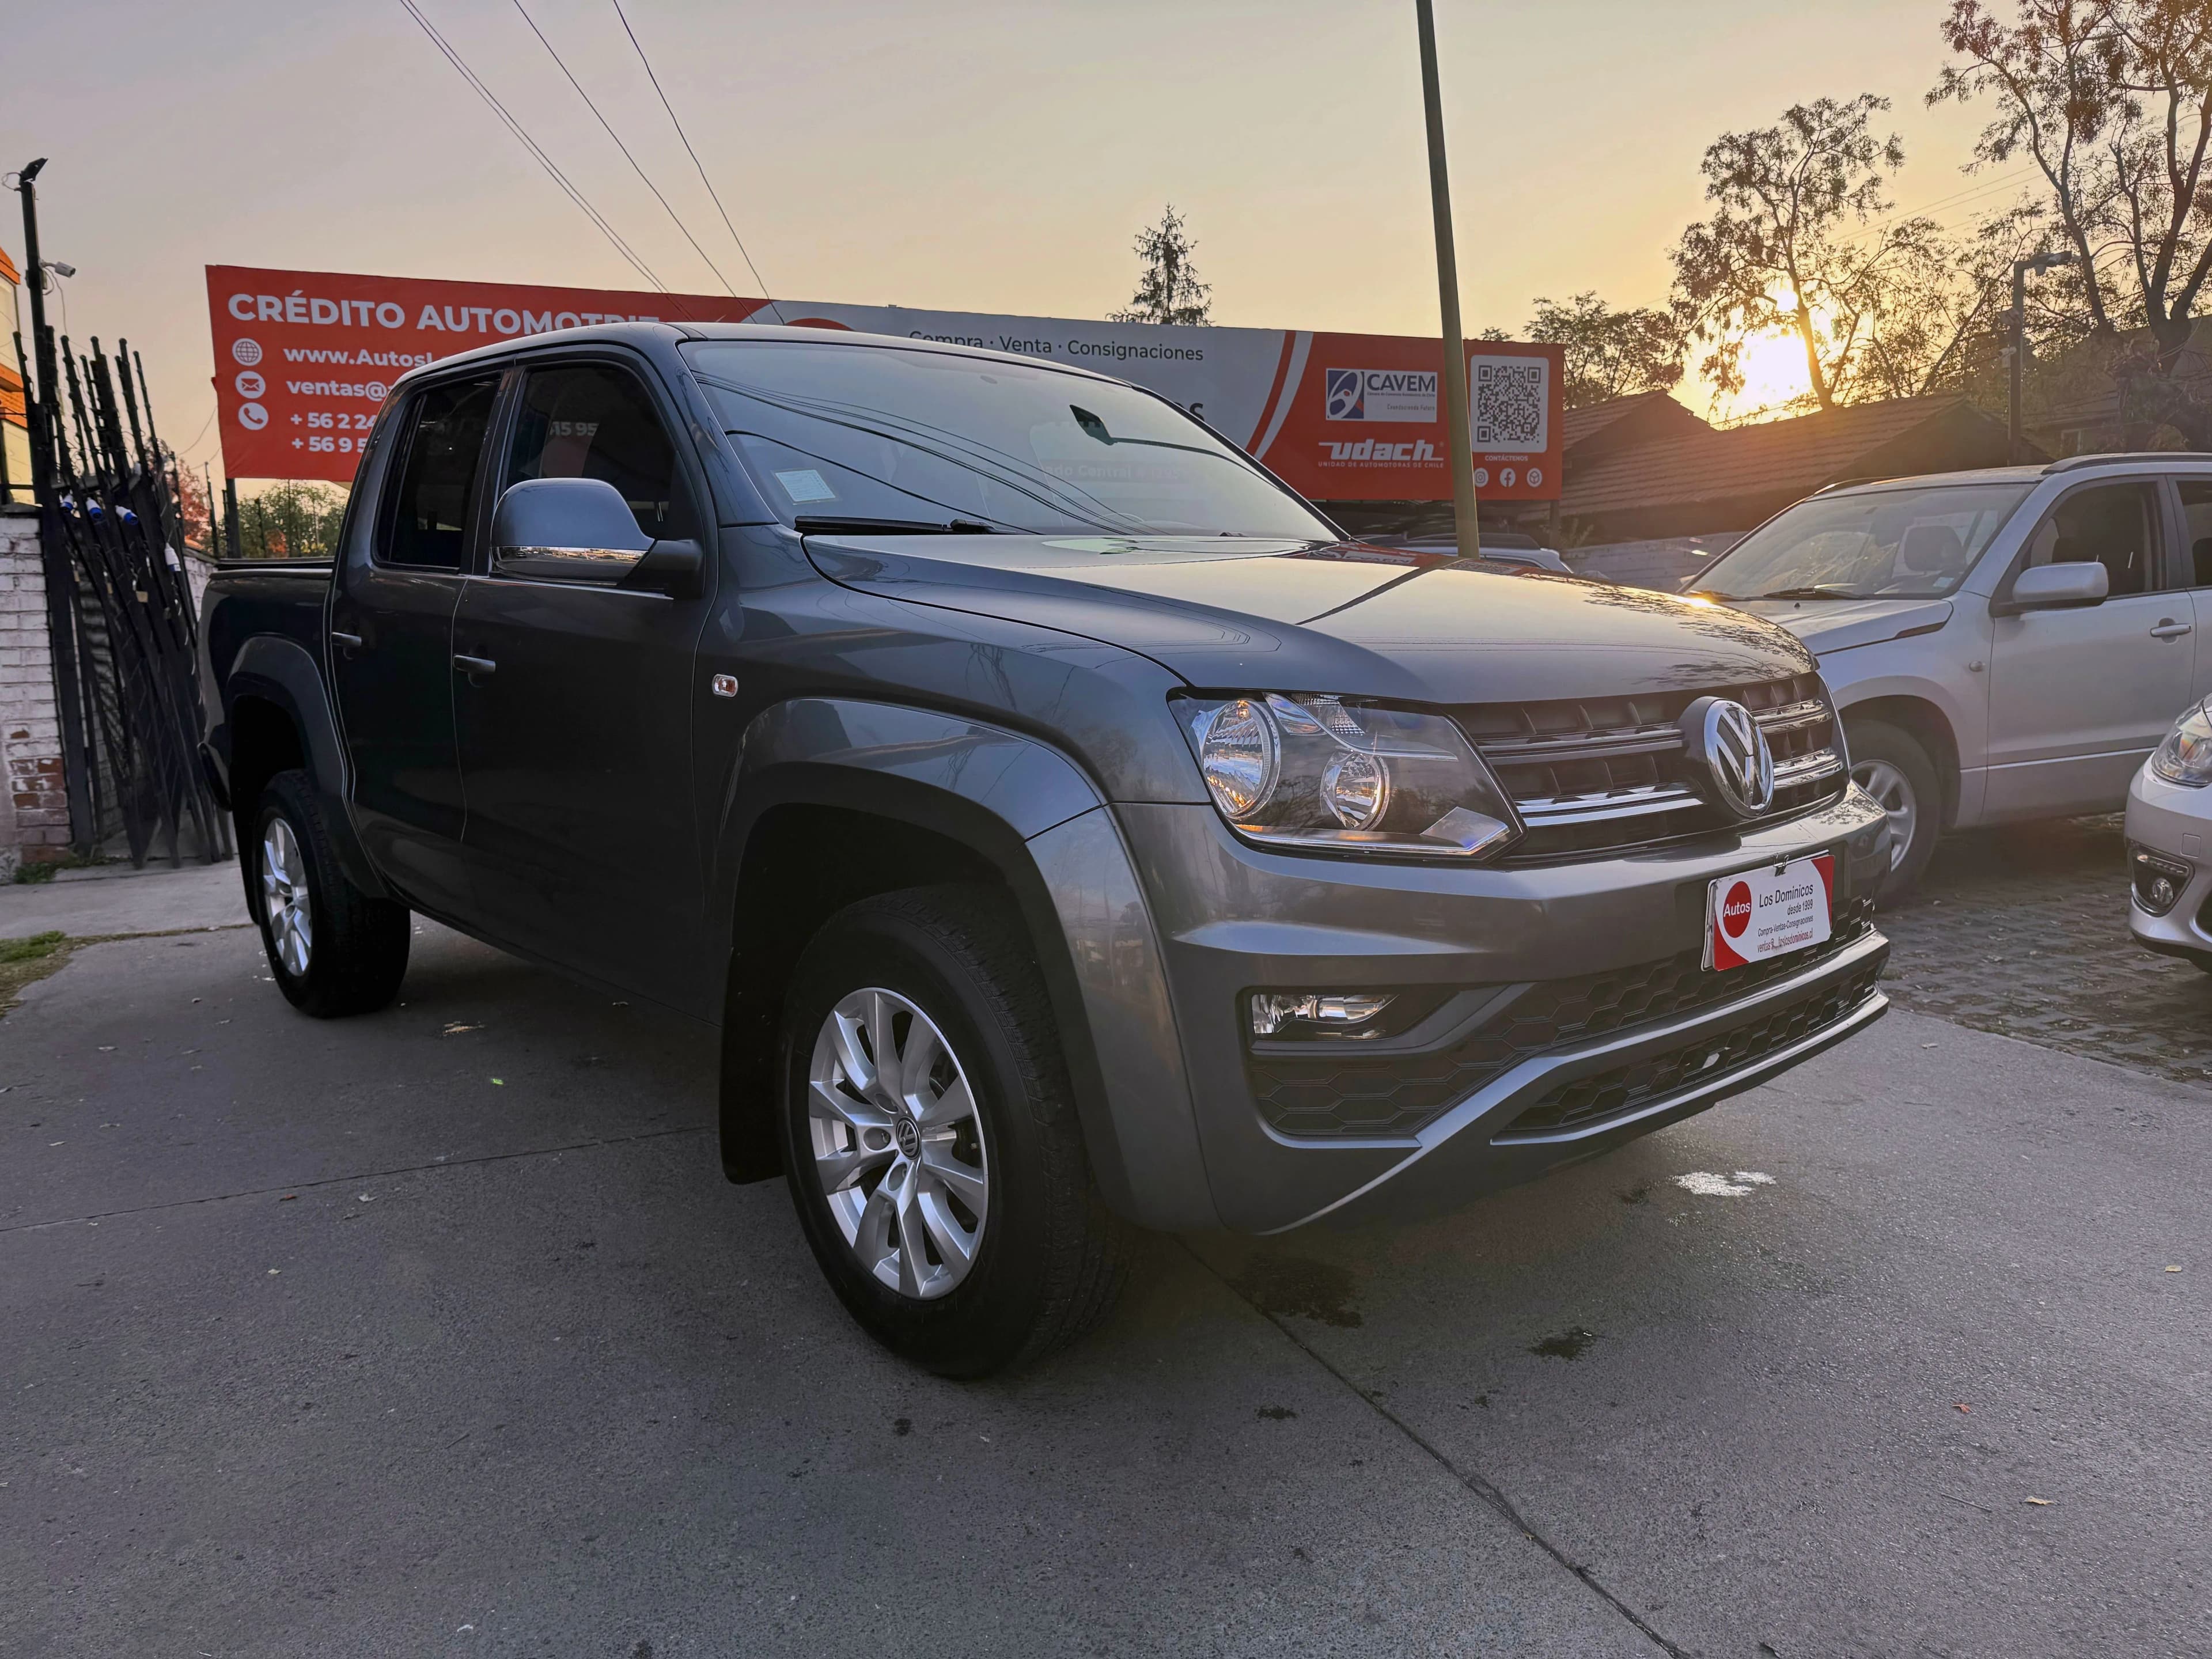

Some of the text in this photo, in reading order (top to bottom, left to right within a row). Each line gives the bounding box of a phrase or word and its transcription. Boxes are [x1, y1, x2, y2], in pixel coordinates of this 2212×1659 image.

[228, 290, 660, 335] CRÉDITO AUTOMOT
[999, 336, 1052, 353] Venta
[1068, 340, 1203, 361] Consignaciones
[283, 349, 449, 368] www.Autos
[286, 380, 394, 402] ventas@
[1367, 374, 1435, 392] CAVEM
[308, 412, 334, 428] 56
[336, 413, 351, 429] 2
[549, 421, 572, 436] 15
[309, 436, 335, 452] 56
[338, 437, 353, 453] 9
[1319, 439, 1444, 461] udach
[1759, 884, 1813, 908] Los Dominicos
[1724, 902, 1751, 917] Autos
[1787, 899, 1813, 915] desde 1999
